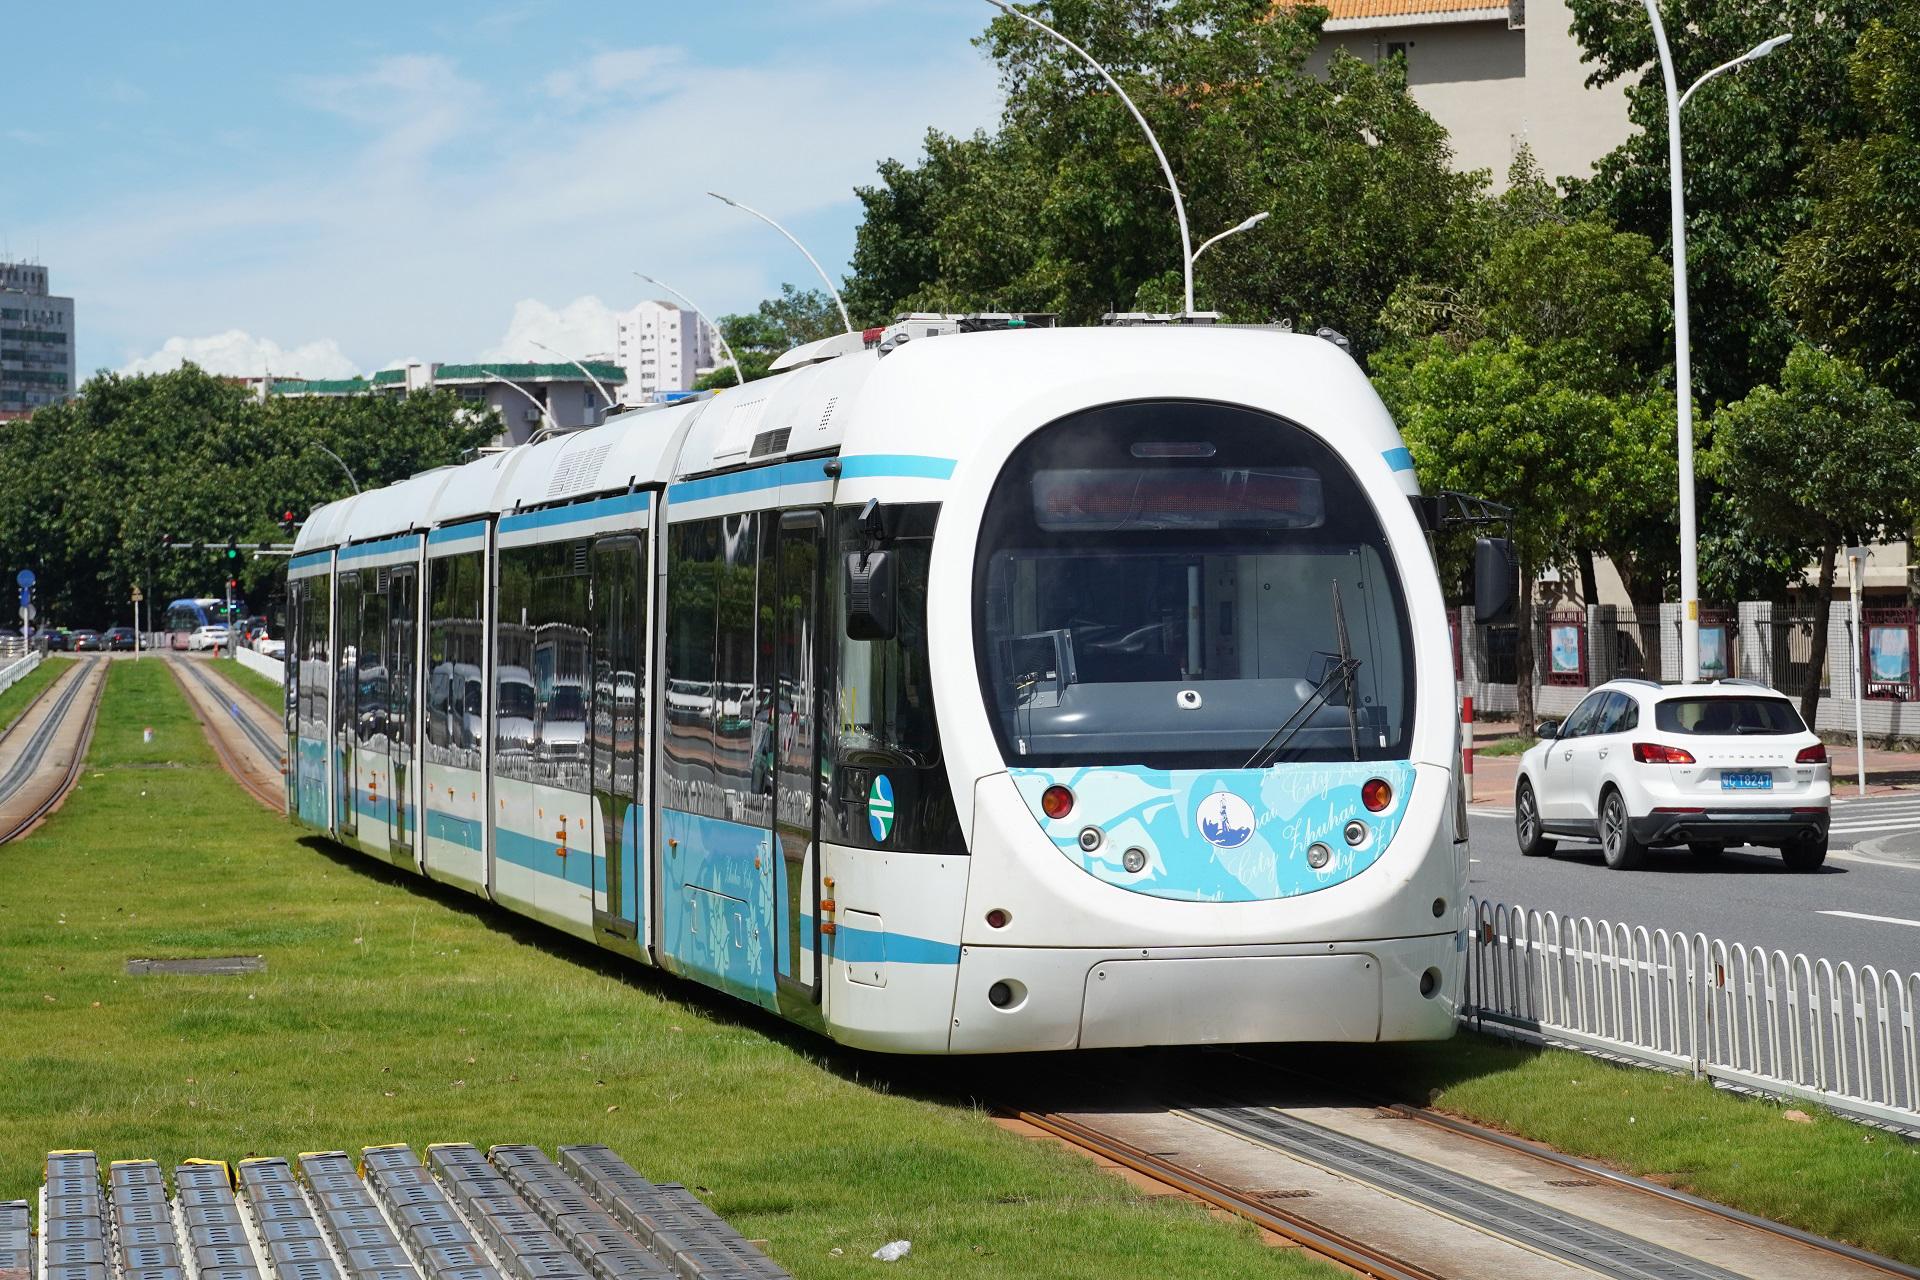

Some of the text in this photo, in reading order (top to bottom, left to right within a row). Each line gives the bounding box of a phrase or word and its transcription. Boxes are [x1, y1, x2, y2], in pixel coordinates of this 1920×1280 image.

[1281, 769, 1332, 801] City
[1282, 798, 1357, 860] Zhuhai
[1227, 848, 1278, 886] City
